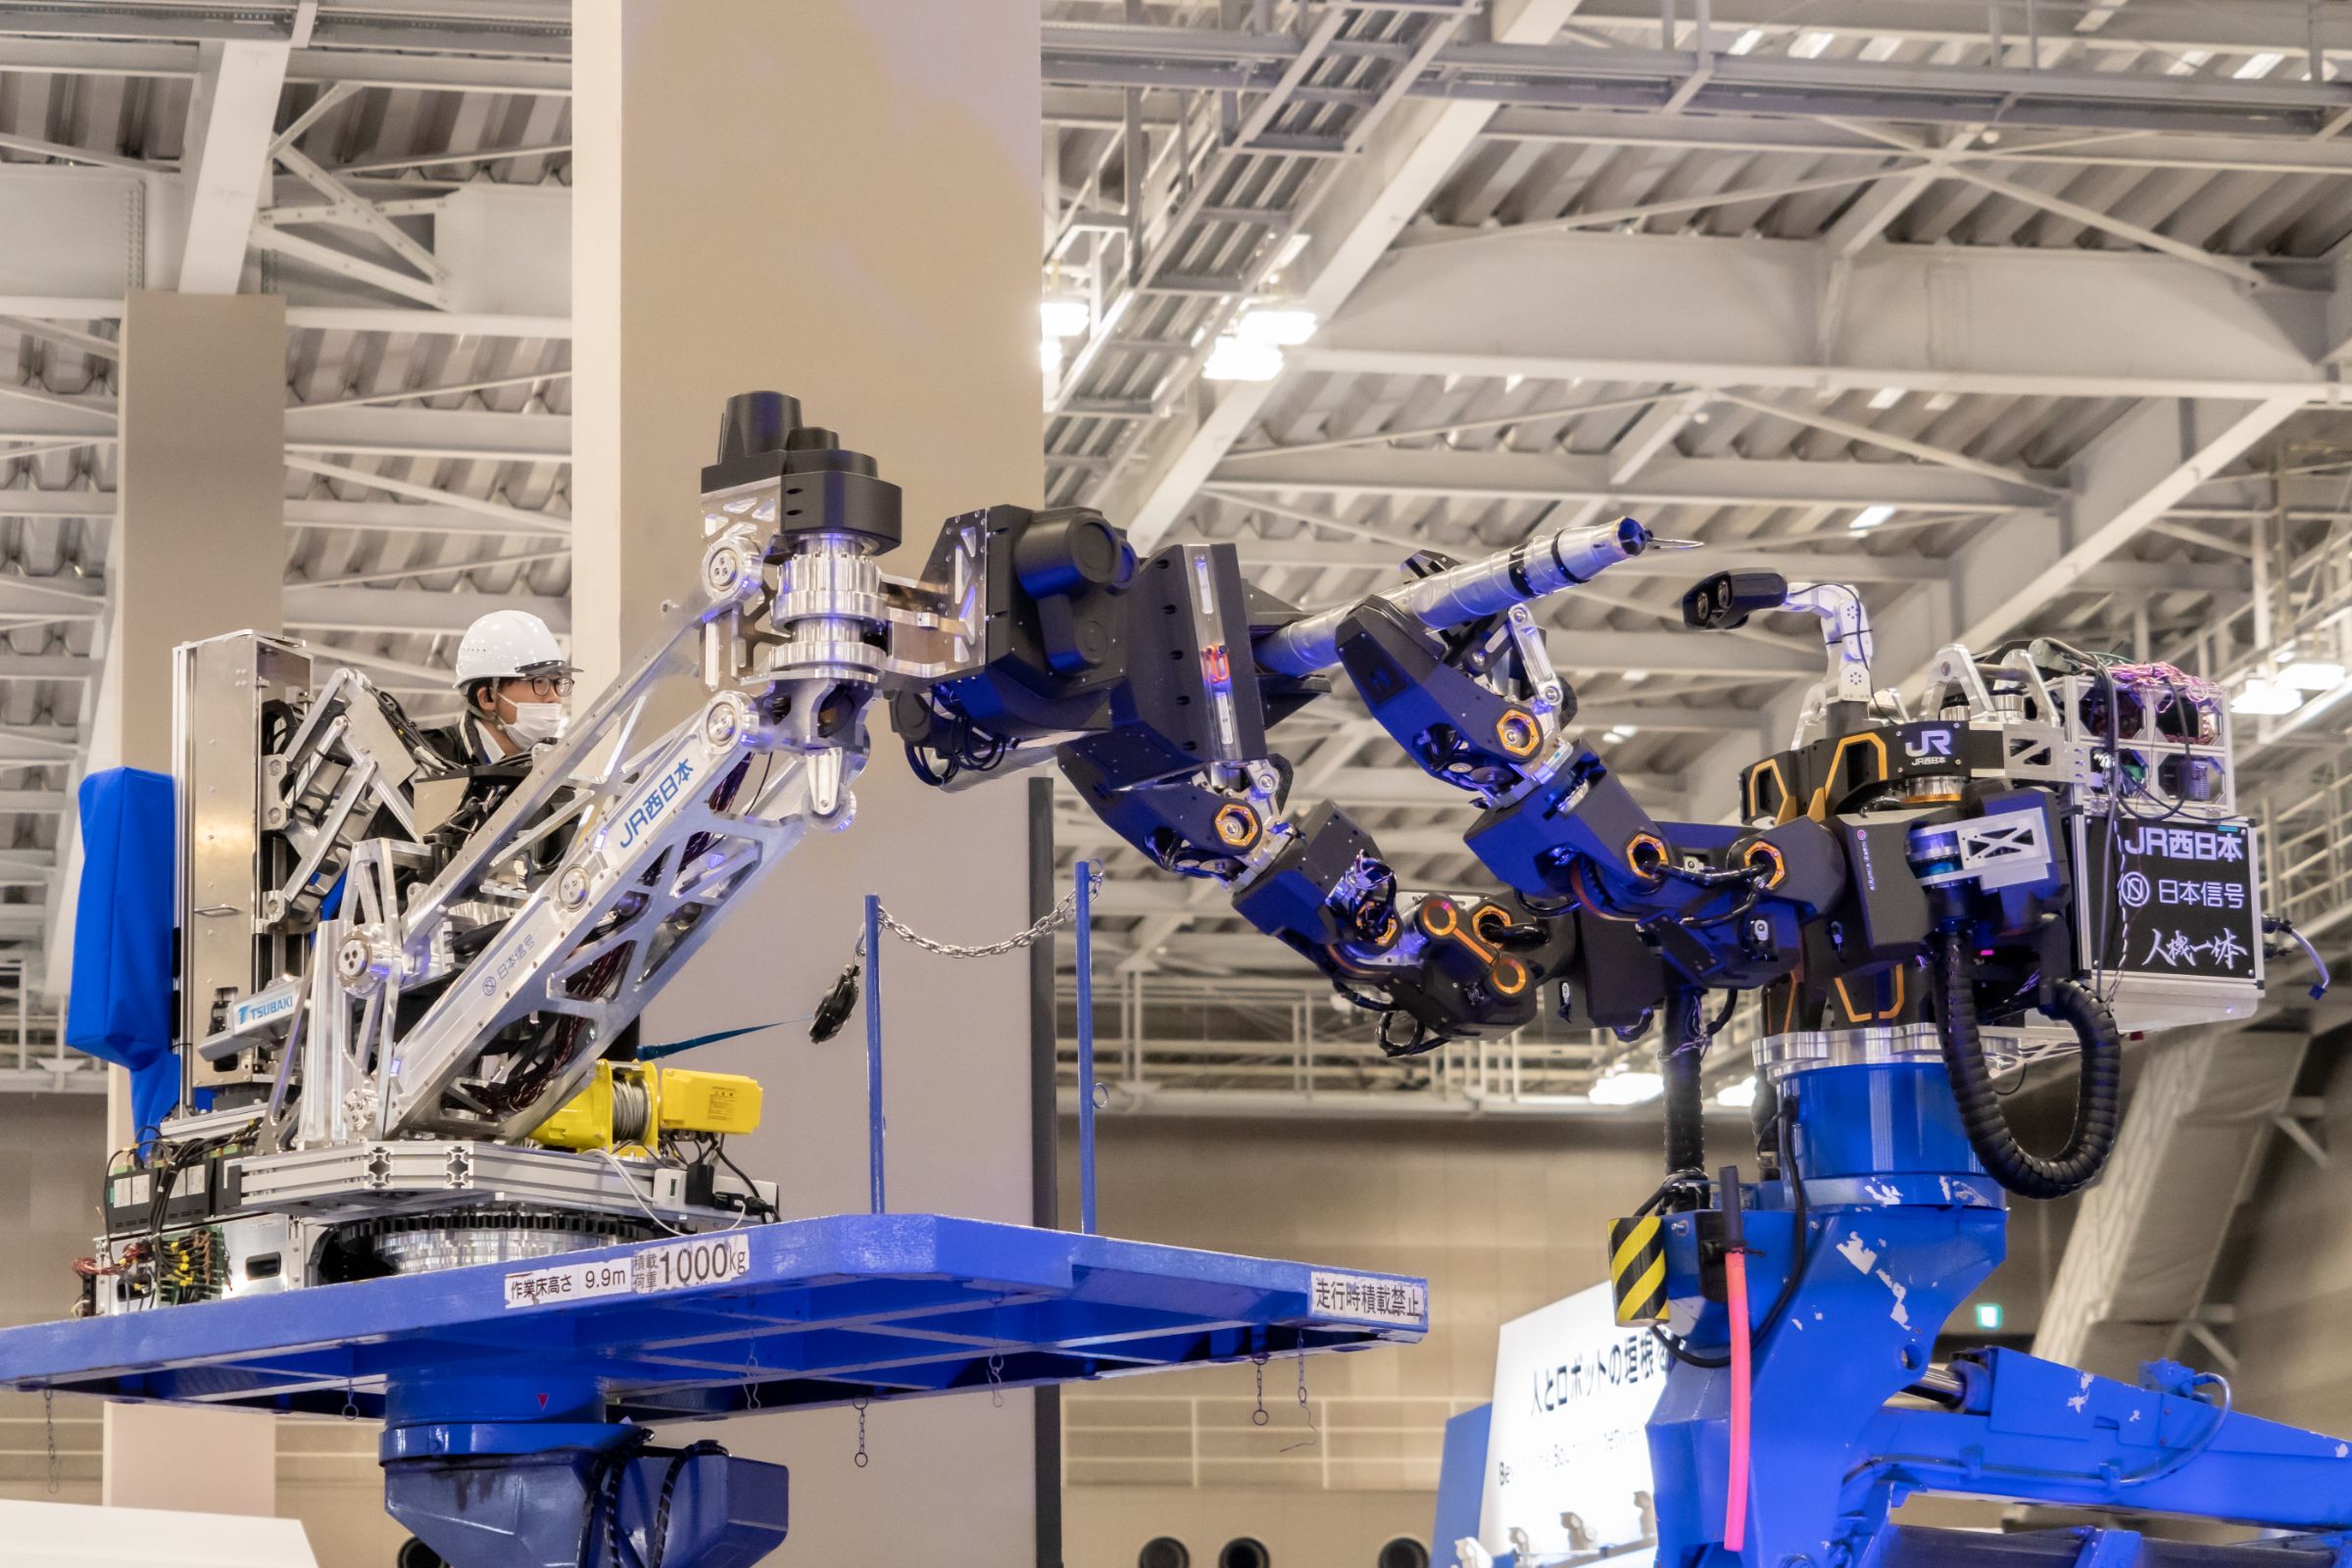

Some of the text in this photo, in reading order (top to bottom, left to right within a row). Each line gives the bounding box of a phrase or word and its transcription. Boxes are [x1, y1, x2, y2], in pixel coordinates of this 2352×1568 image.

[1904, 729, 1952, 758] JR
[1911, 756, 1946, 766] JR西日本
[619, 758, 694, 849] JR西日本
[2124, 826, 2243, 863] JR西日本
[2158, 878, 2245, 909] 日本信号
[2141, 927, 2249, 970] 人機一体
[250, 995, 293, 1021] TSUBAKI
[634, 1252, 659, 1272] 積載
[510, 1268, 626, 1301] 作業床高さ 9.9m
[635, 1272, 659, 1291] 荷重
[1315, 1278, 1423, 1317] 走行時積載禁止
